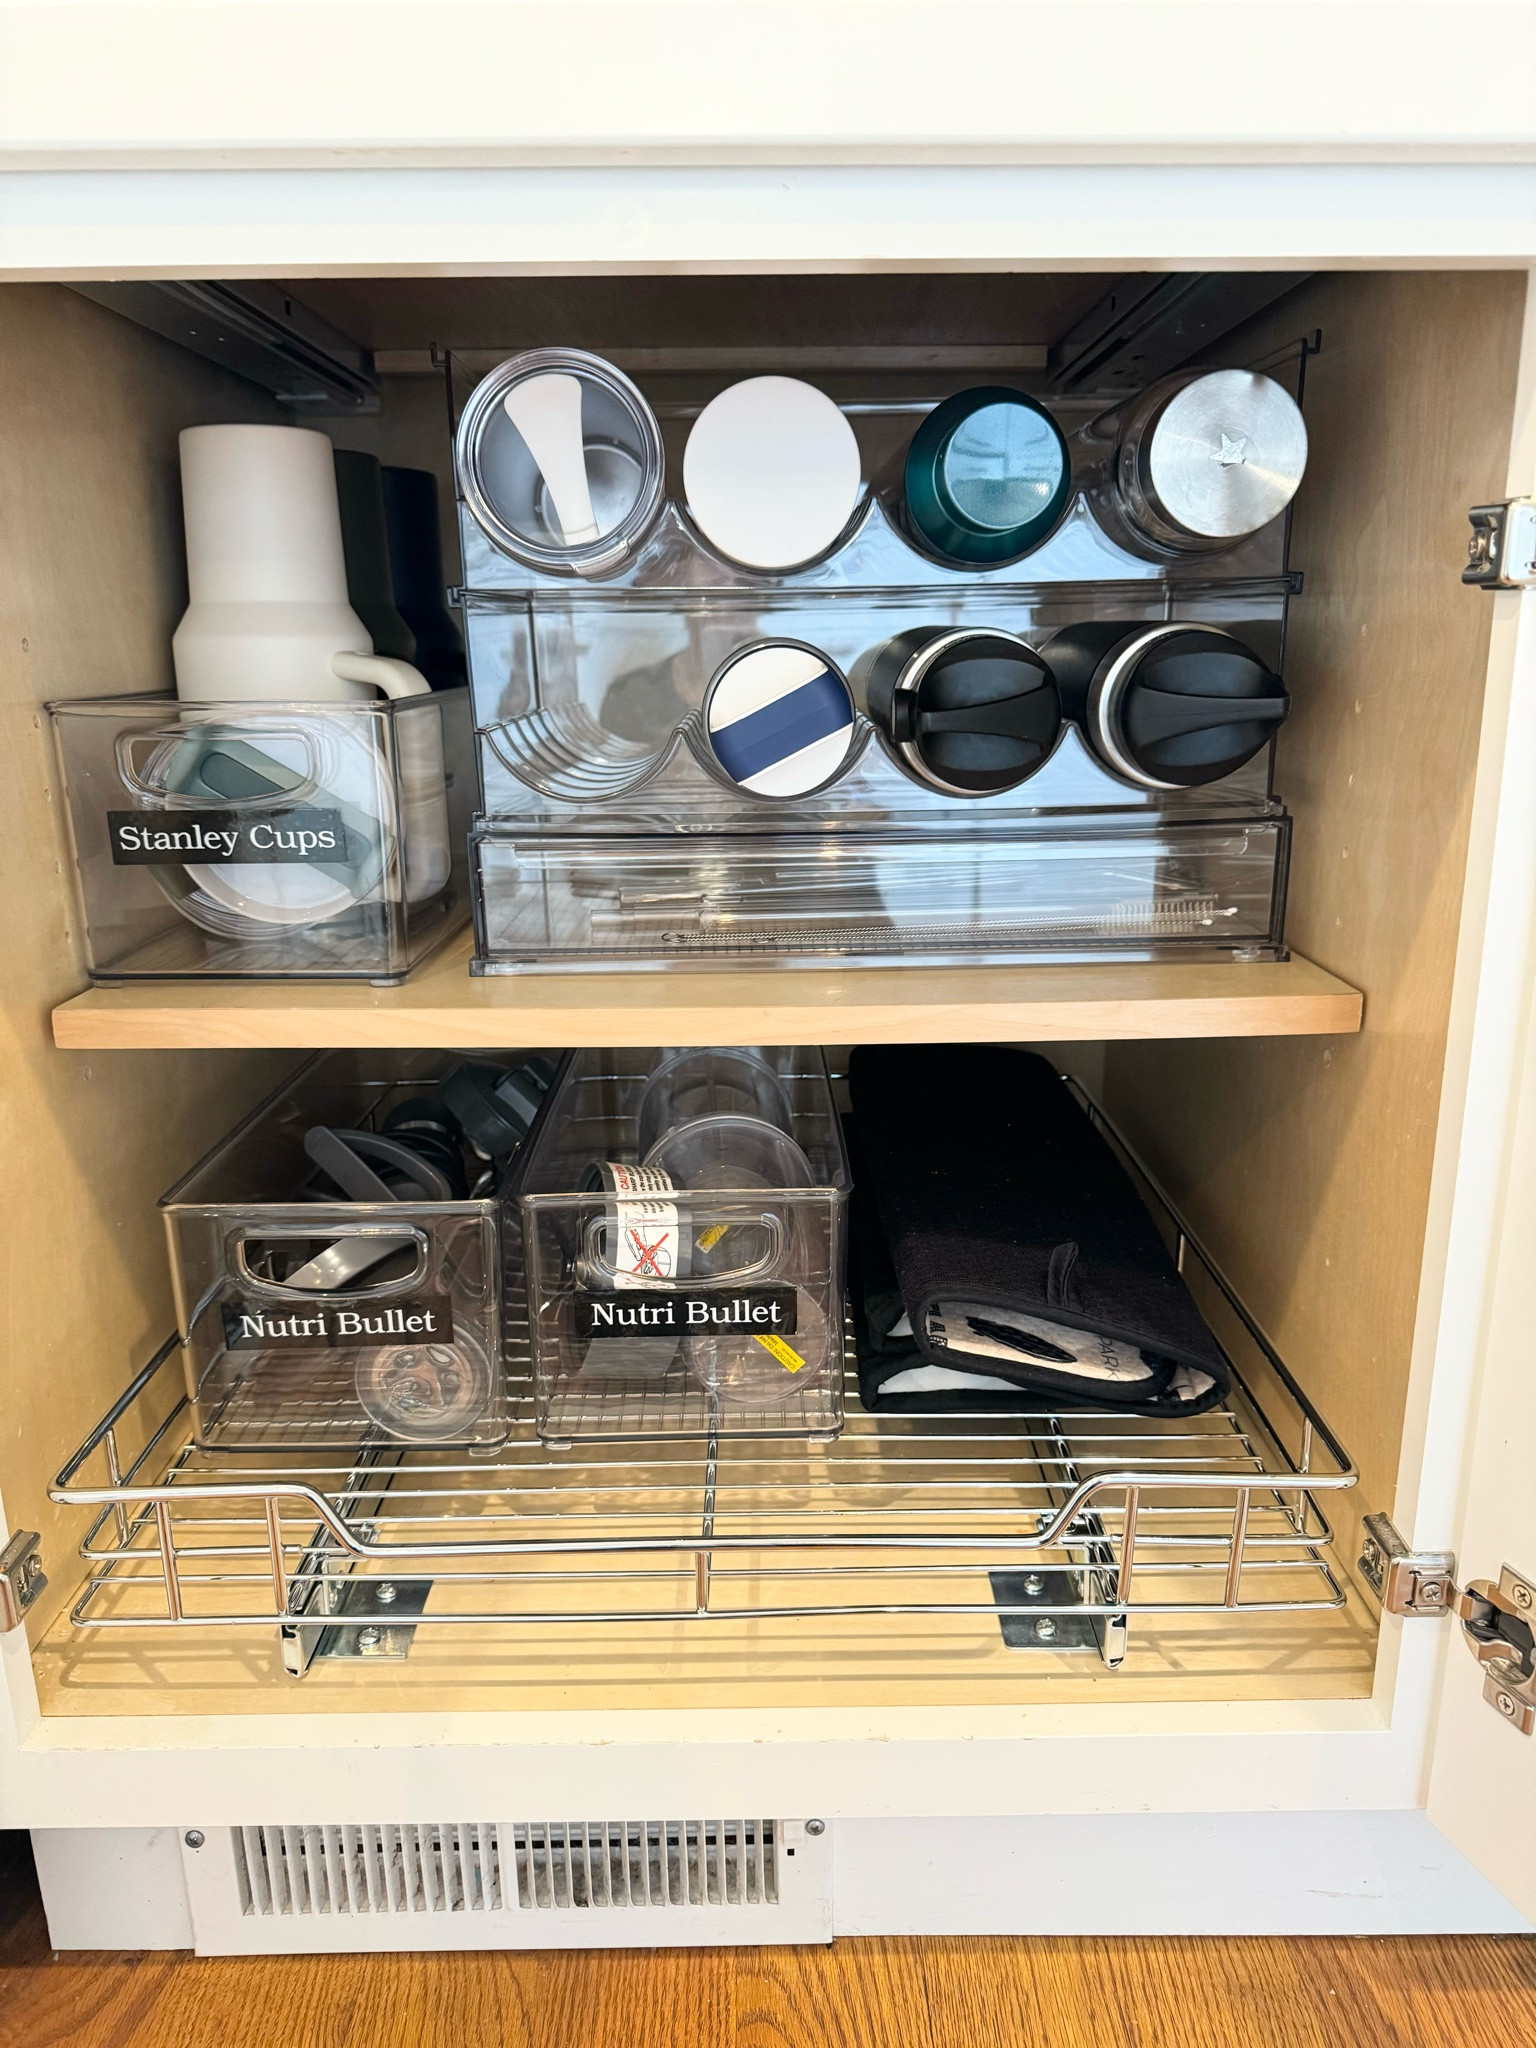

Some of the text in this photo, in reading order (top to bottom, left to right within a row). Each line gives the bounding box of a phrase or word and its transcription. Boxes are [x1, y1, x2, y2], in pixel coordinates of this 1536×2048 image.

[119, 824, 336, 857] Stanley Cups
[239, 1309, 437, 1338] Nutri Bullet
[590, 1299, 783, 1326] Nutri Bullet
